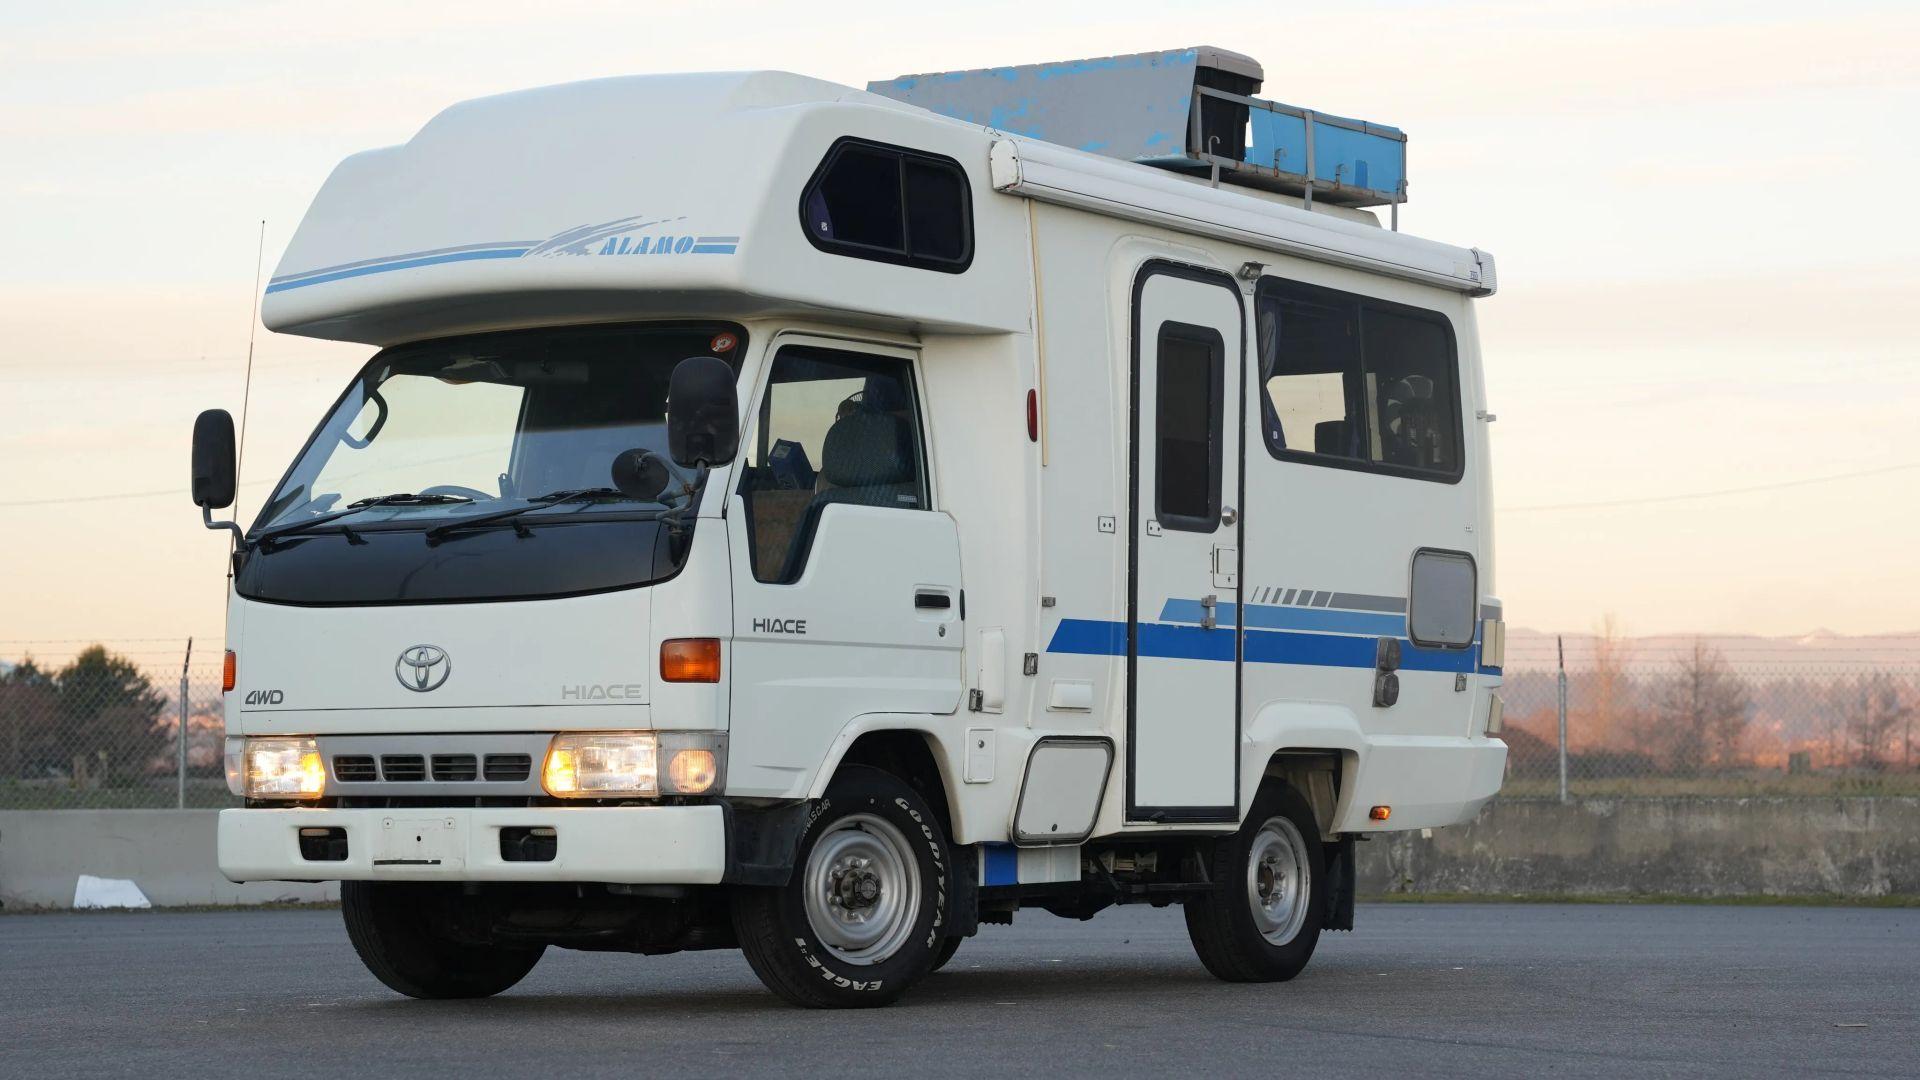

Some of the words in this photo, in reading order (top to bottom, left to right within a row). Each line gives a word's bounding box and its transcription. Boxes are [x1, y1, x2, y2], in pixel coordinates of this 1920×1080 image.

[598, 236, 695, 256] ALAMO
[753, 618, 806, 634] HIACE
[245, 690, 284, 704] 4WD
[561, 684, 642, 700] HIACE
[895, 797, 945, 949] GOODYEAR
[804, 954, 883, 991] EAGLE
